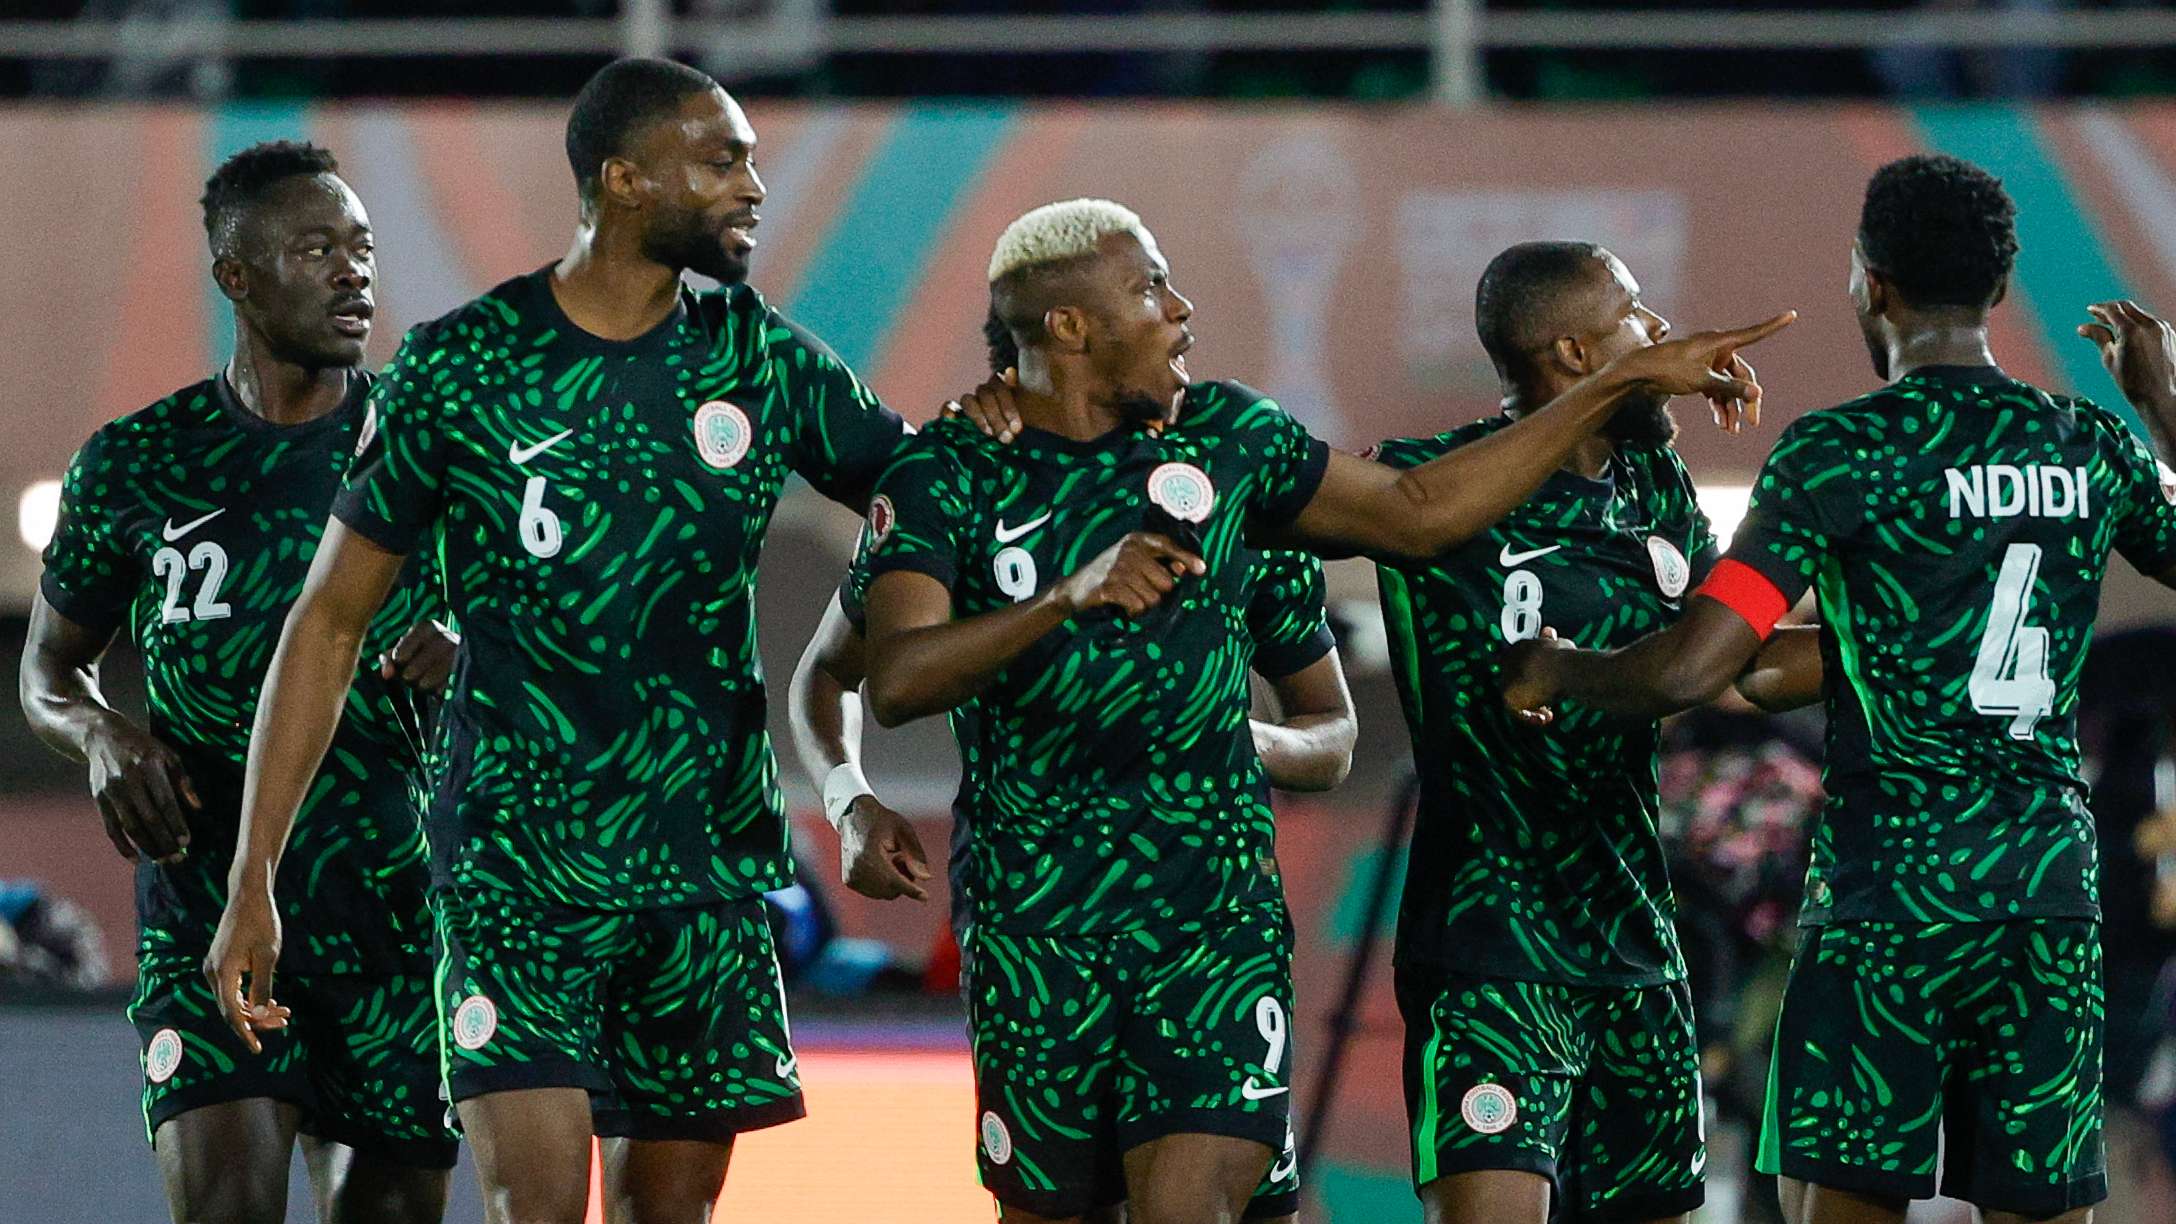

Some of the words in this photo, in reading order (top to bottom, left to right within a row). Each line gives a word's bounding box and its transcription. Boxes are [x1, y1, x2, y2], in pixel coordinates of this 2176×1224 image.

[518, 475, 563, 558] 6
[1944, 464, 2089, 519] NDIDI
[152, 541, 231, 624] 22
[993, 546, 1038, 603] 9
[1501, 569, 1543, 645] 8
[1968, 543, 2056, 740] 4
[1255, 996, 1286, 1074] 9
